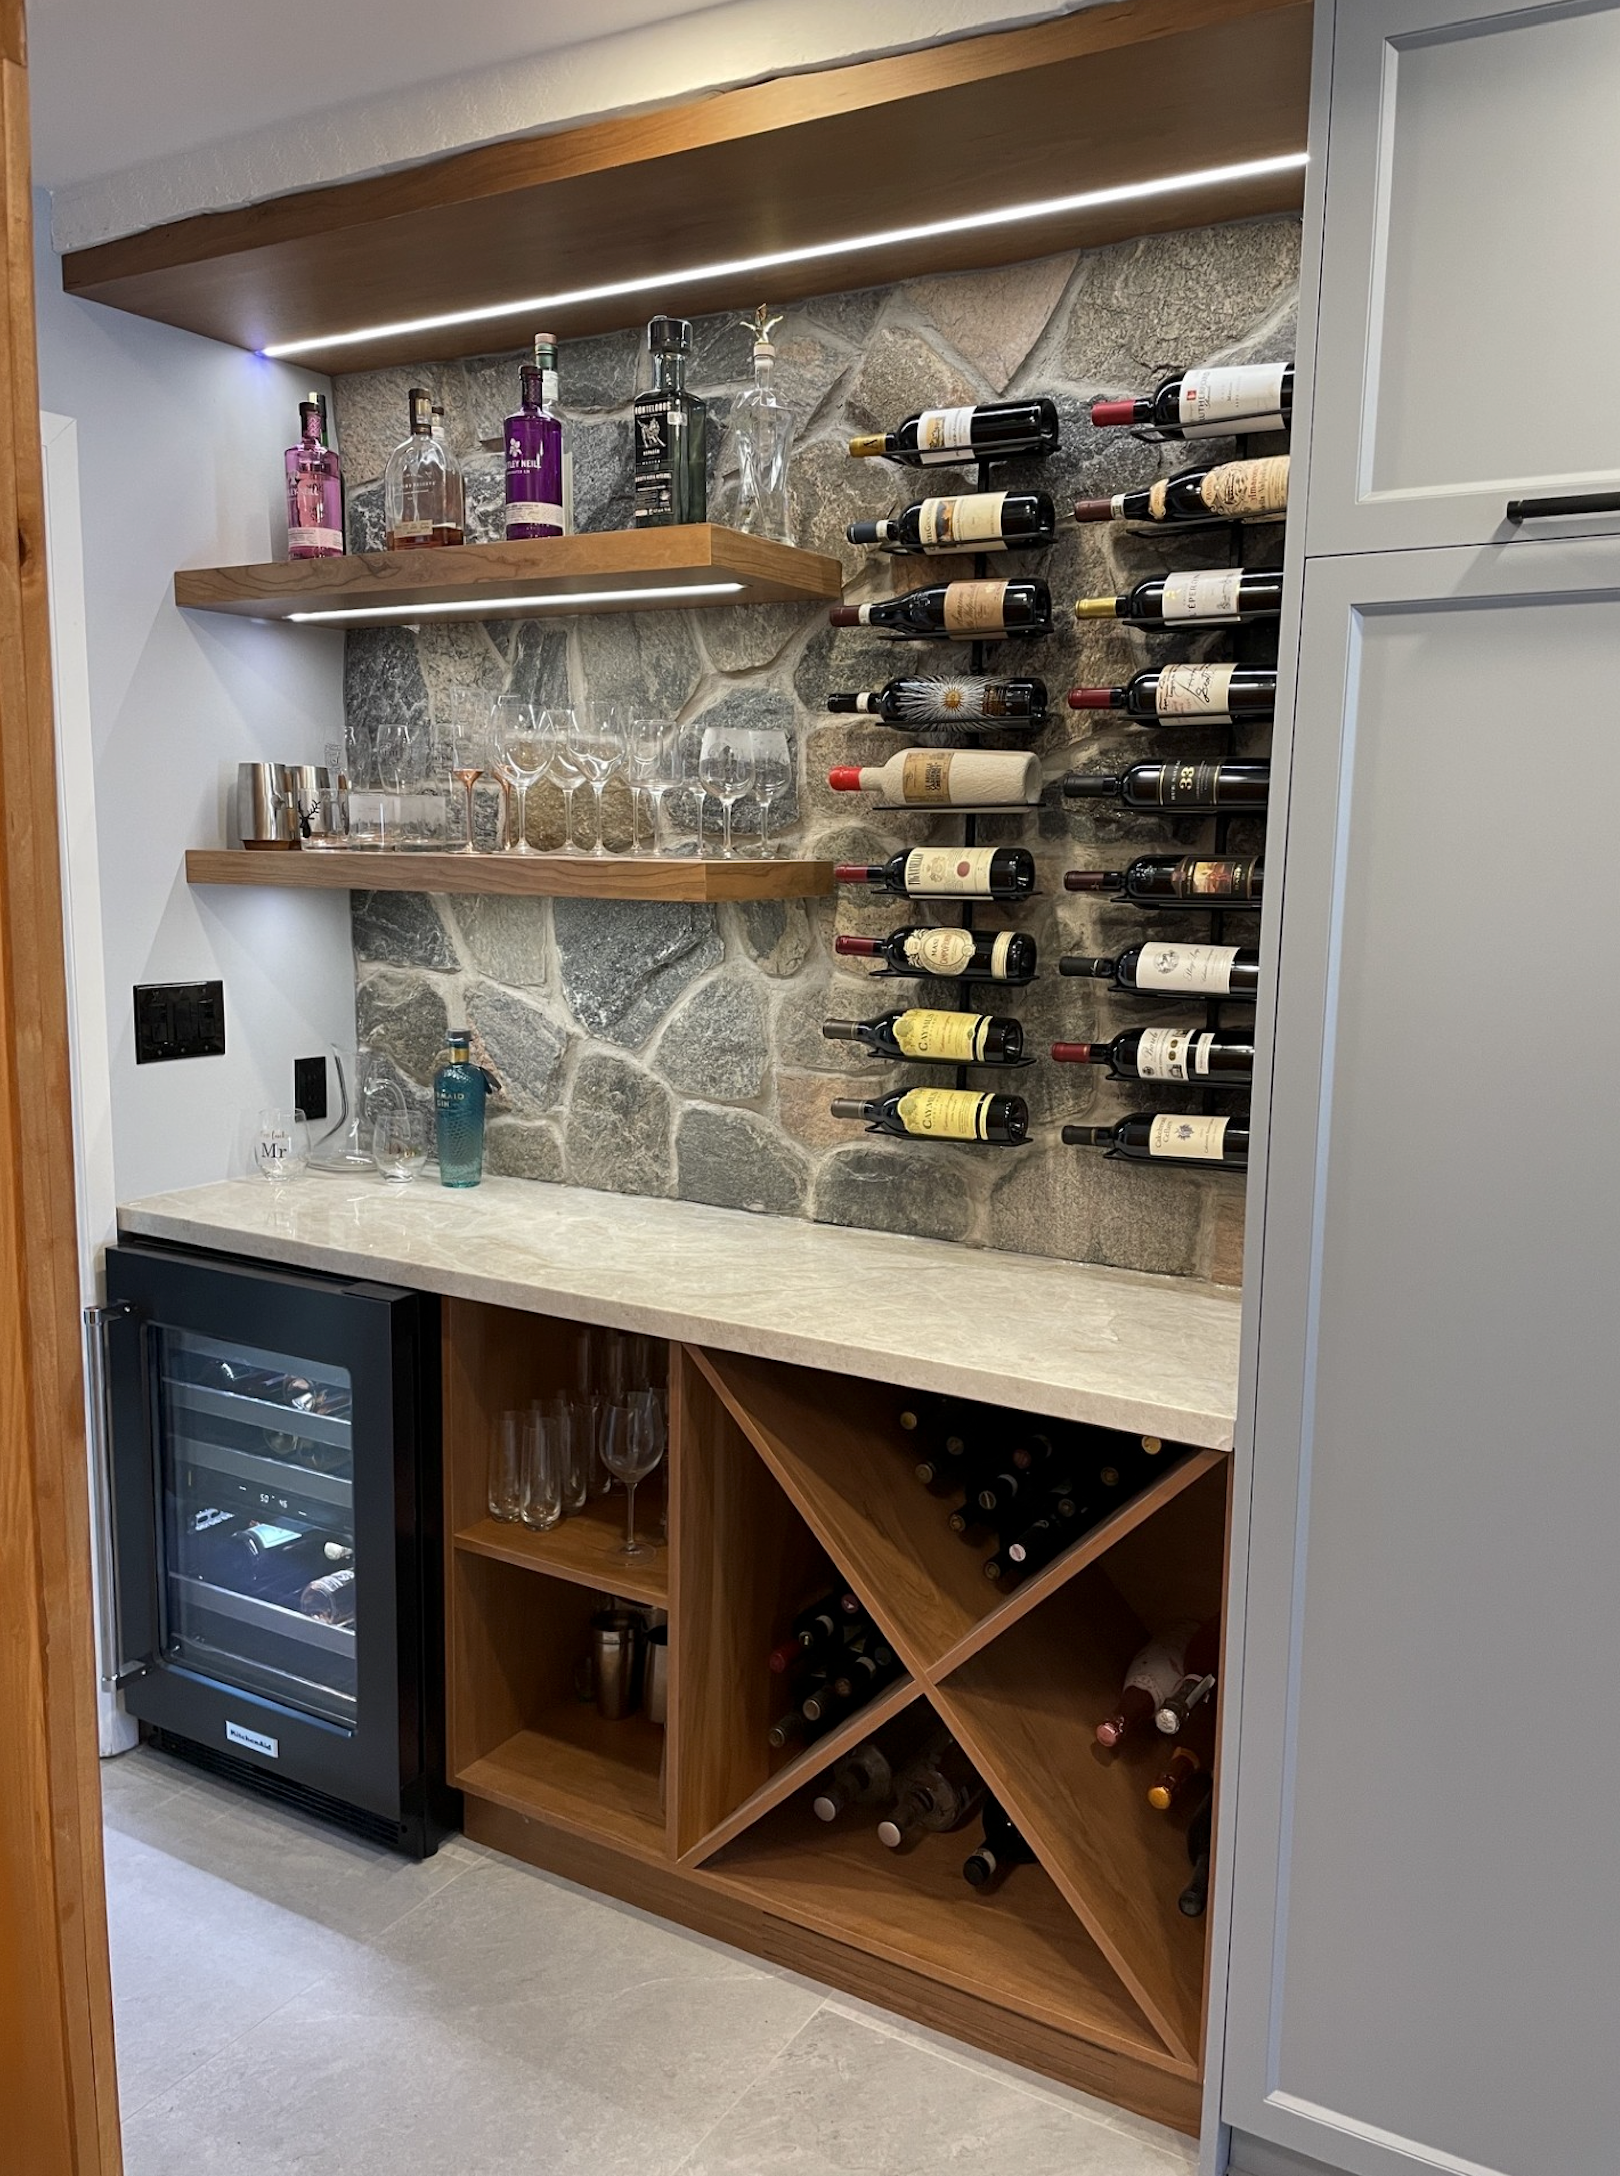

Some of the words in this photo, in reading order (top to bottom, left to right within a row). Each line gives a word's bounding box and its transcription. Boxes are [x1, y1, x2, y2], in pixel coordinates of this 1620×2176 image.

[863, 439, 878, 448] A
[1181, 766, 1194, 790] 33
[907, 853, 924, 885] TIGNANELLO
[931, 938, 939, 957] MASI
[918, 1013, 934, 1052] CAYMUS
[922, 1092, 938, 1130] CAYMUS
[261, 1142, 287, 1158] Mr
[230, 1729, 272, 1751] KitchenAid
